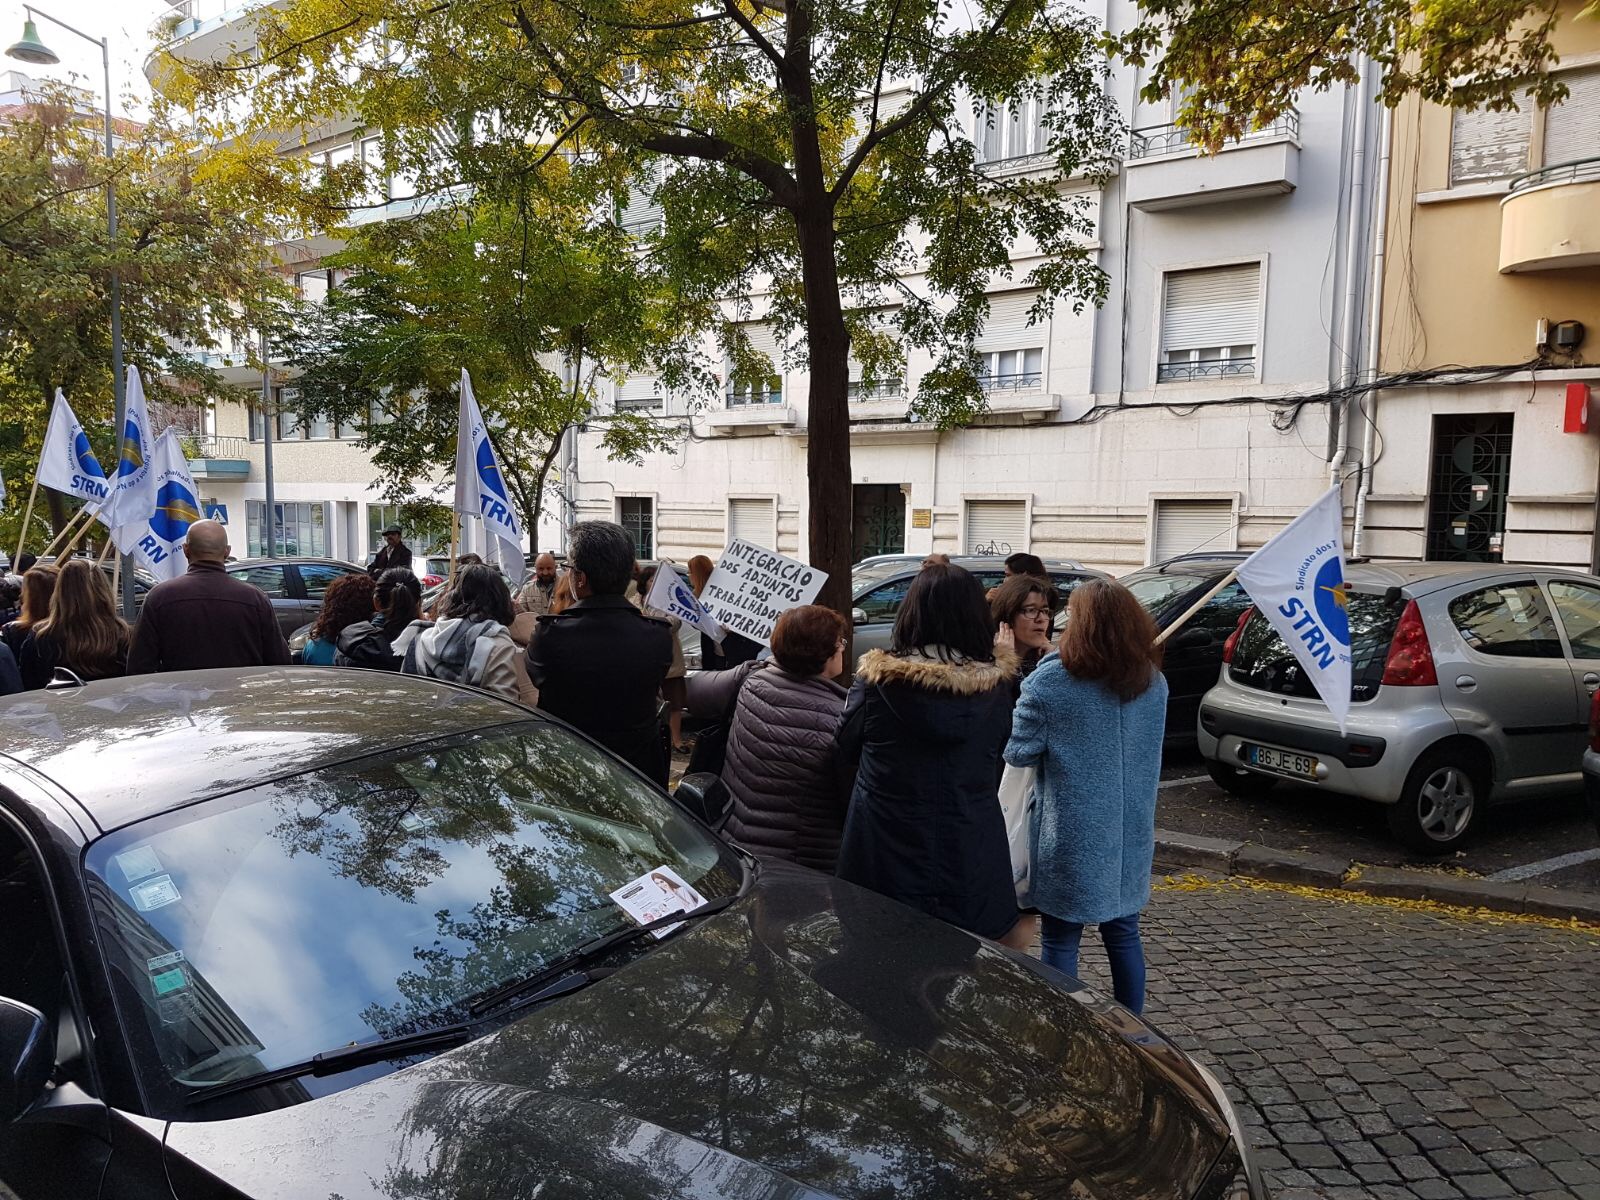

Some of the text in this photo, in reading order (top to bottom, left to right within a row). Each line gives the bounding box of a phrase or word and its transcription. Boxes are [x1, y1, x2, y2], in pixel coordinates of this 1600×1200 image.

[71, 474, 109, 498] STRN
[480, 494, 517, 535] TRN
[139, 534, 168, 564] RN
[728, 538, 813, 586] INTEGRAÇÃO
[1296, 544, 1332, 591] Sindicato dos
[720, 559, 804, 602] DOS ADJUNTOS
[739, 582, 772, 602] E DOS
[668, 603, 700, 624] STRN
[702, 601, 713, 614] DO
[715, 608, 773, 640] NOTARIAD
[707, 585, 781, 622] TRABALHADOR
[1278, 597, 1335, 670] STRN
[1258, 748, 1311, 774] 86-JE-69
